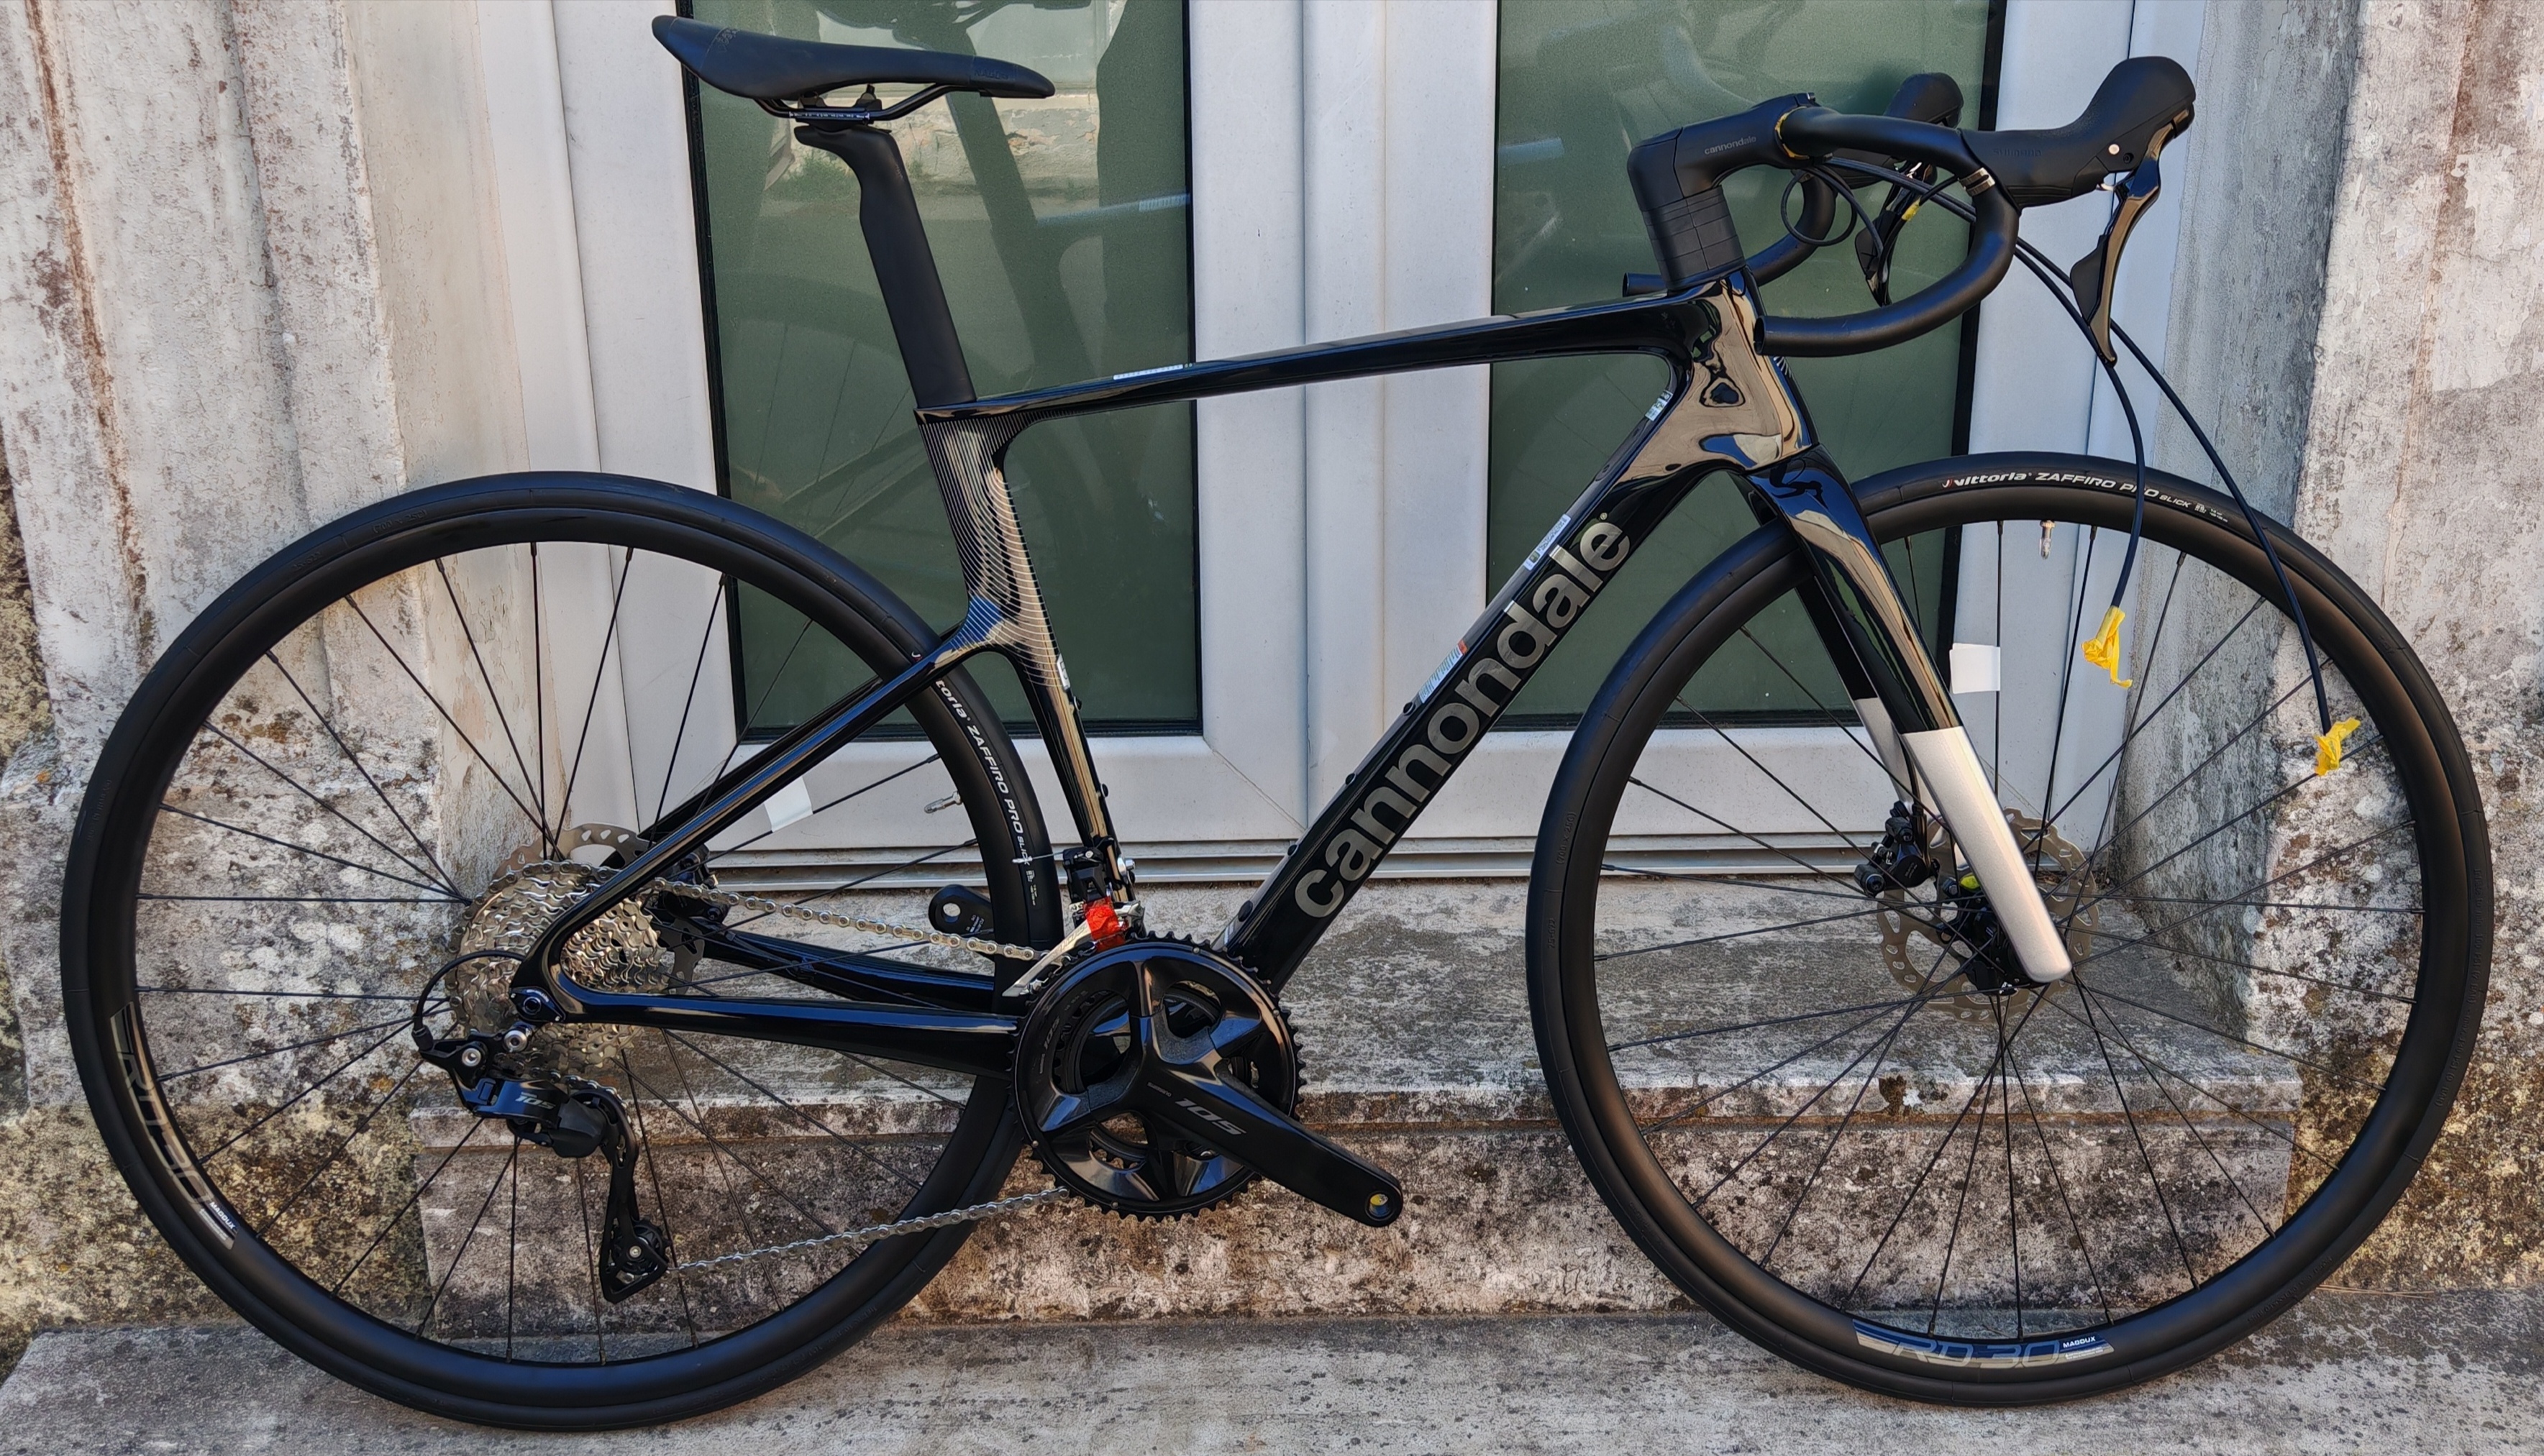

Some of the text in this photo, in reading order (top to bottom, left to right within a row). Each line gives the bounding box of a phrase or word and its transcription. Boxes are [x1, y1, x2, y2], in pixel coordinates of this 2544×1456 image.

[2035, 472, 2117, 489] ZAFFIRO
[2119, 482, 2160, 498] PO
[1295, 519, 1631, 920] cannondale
[967, 725, 1009, 795] ZAFFIRO
[1004, 798, 1023, 834] PRO
[514, 1094, 557, 1110] 105
[1175, 1098, 1247, 1135] 105
[209, 1201, 236, 1230] MADDUX
[2062, 1336, 2096, 1349] MADDUX
